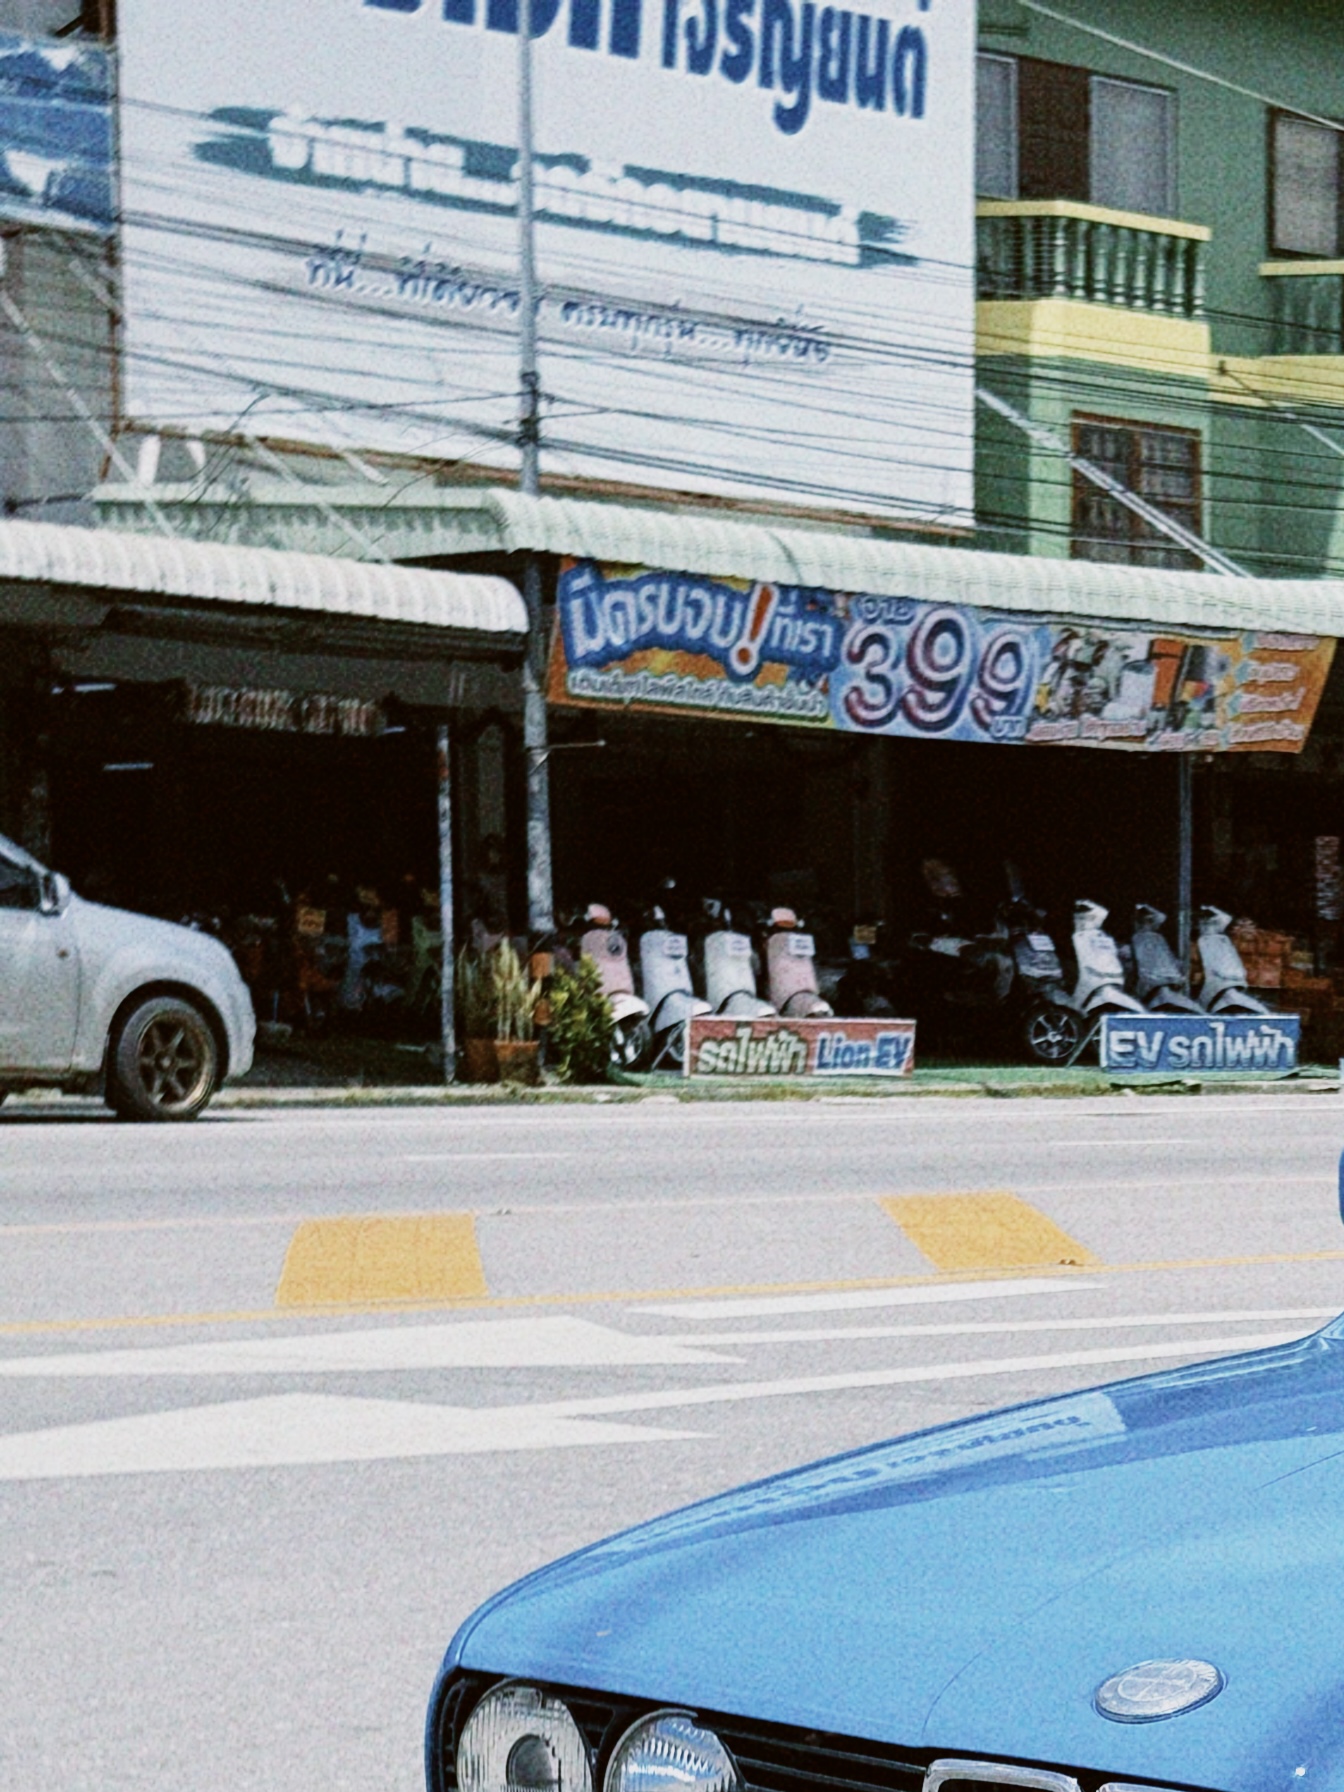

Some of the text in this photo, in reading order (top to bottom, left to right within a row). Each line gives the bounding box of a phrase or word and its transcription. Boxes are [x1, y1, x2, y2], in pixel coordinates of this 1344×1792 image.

[660, 0, 930, 135] เจรญยนต
[844, 607, 1026, 734] 399
[1109, 1021, 1296, 1068] EV รถไฟฟ้า
